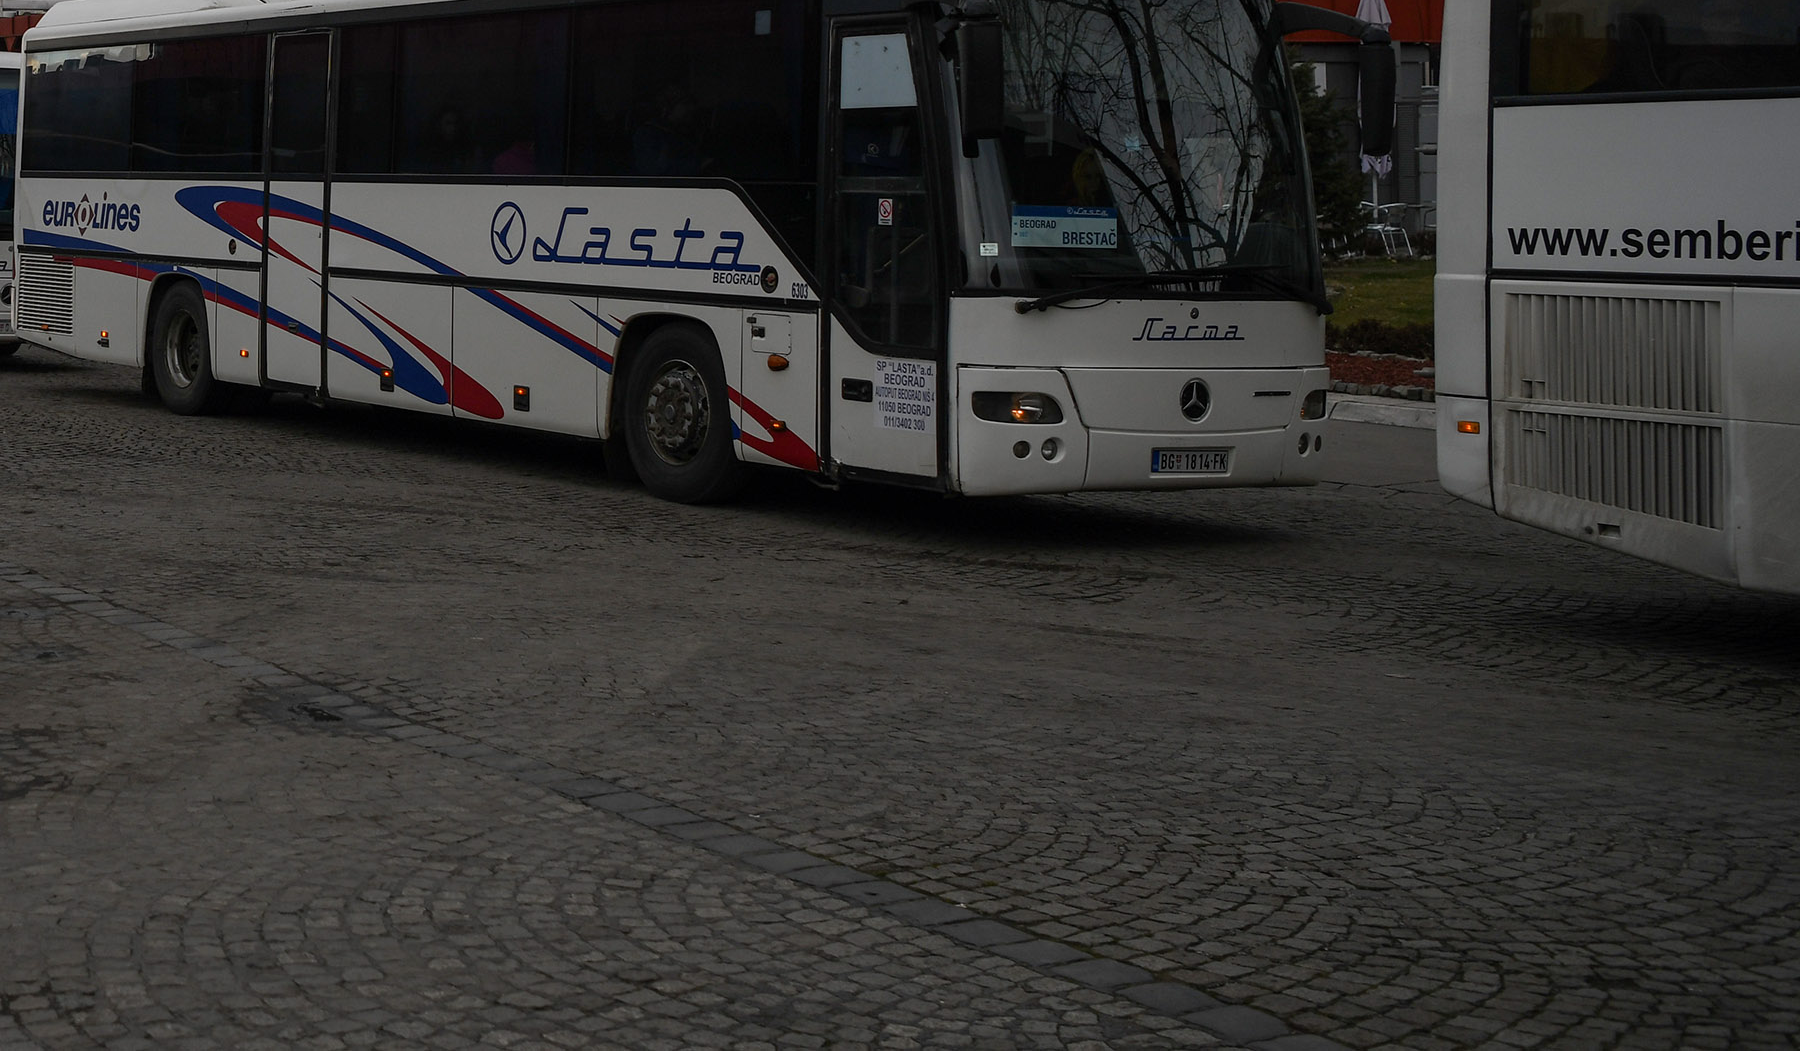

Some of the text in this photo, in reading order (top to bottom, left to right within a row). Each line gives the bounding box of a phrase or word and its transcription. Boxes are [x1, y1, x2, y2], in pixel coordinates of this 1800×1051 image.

[1019, 219, 1057, 229] BEOGRAD
[533, 207, 761, 272] Lasta
[1062, 229, 1117, 246] BRESTAČ
[713, 272, 760, 286] BEOGRAD
[791, 282, 809, 300] 6303
[876, 360, 887, 371] SP
[884, 373, 925, 388] BEOGRAD
[898, 388, 921, 401] BEOGRAD
[897, 402, 931, 417] BEOGRAD
[1160, 453, 1175, 470] BG
